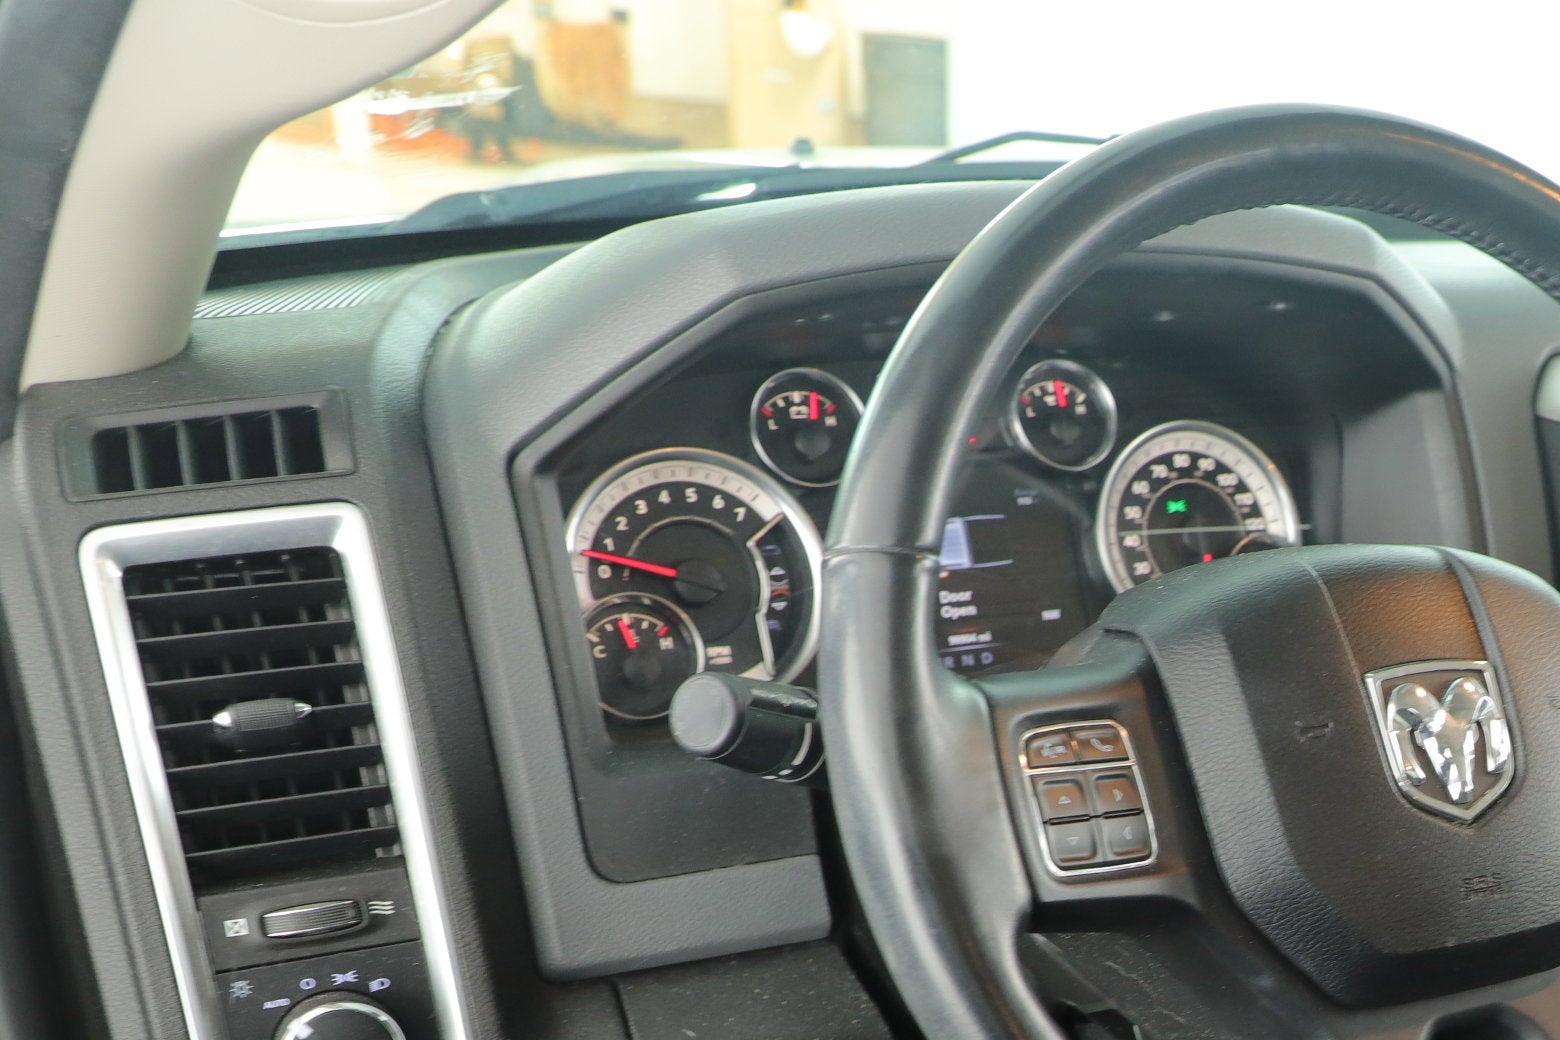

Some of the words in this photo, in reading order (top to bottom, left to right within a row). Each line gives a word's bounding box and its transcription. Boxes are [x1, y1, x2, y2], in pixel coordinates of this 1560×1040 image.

[1172, 453, 1192, 468] 80
[1197, 457, 1217, 471] 90
[1149, 464, 1169, 478] 70
[1216, 473, 1239, 487] 100
[1131, 480, 1151, 495] 60
[658, 489, 672, 504] 4
[684, 488, 699, 503] 5
[712, 494, 726, 509] 6
[634, 500, 649, 514] 3
[733, 507, 747, 521] 7
[1123, 505, 1143, 520] 50
[615, 516, 629, 531] 2
[603, 537, 616, 551] 1
[597, 564, 612, 579] 0
[938, 590, 973, 604] Door
[940, 605, 978, 620] Open
[659, 636, 674, 650] H
[593, 645, 608, 658] C
[961, 654, 976, 667] N
[980, 652, 995, 665] D
[262, 997, 292, 1010] AUTO
